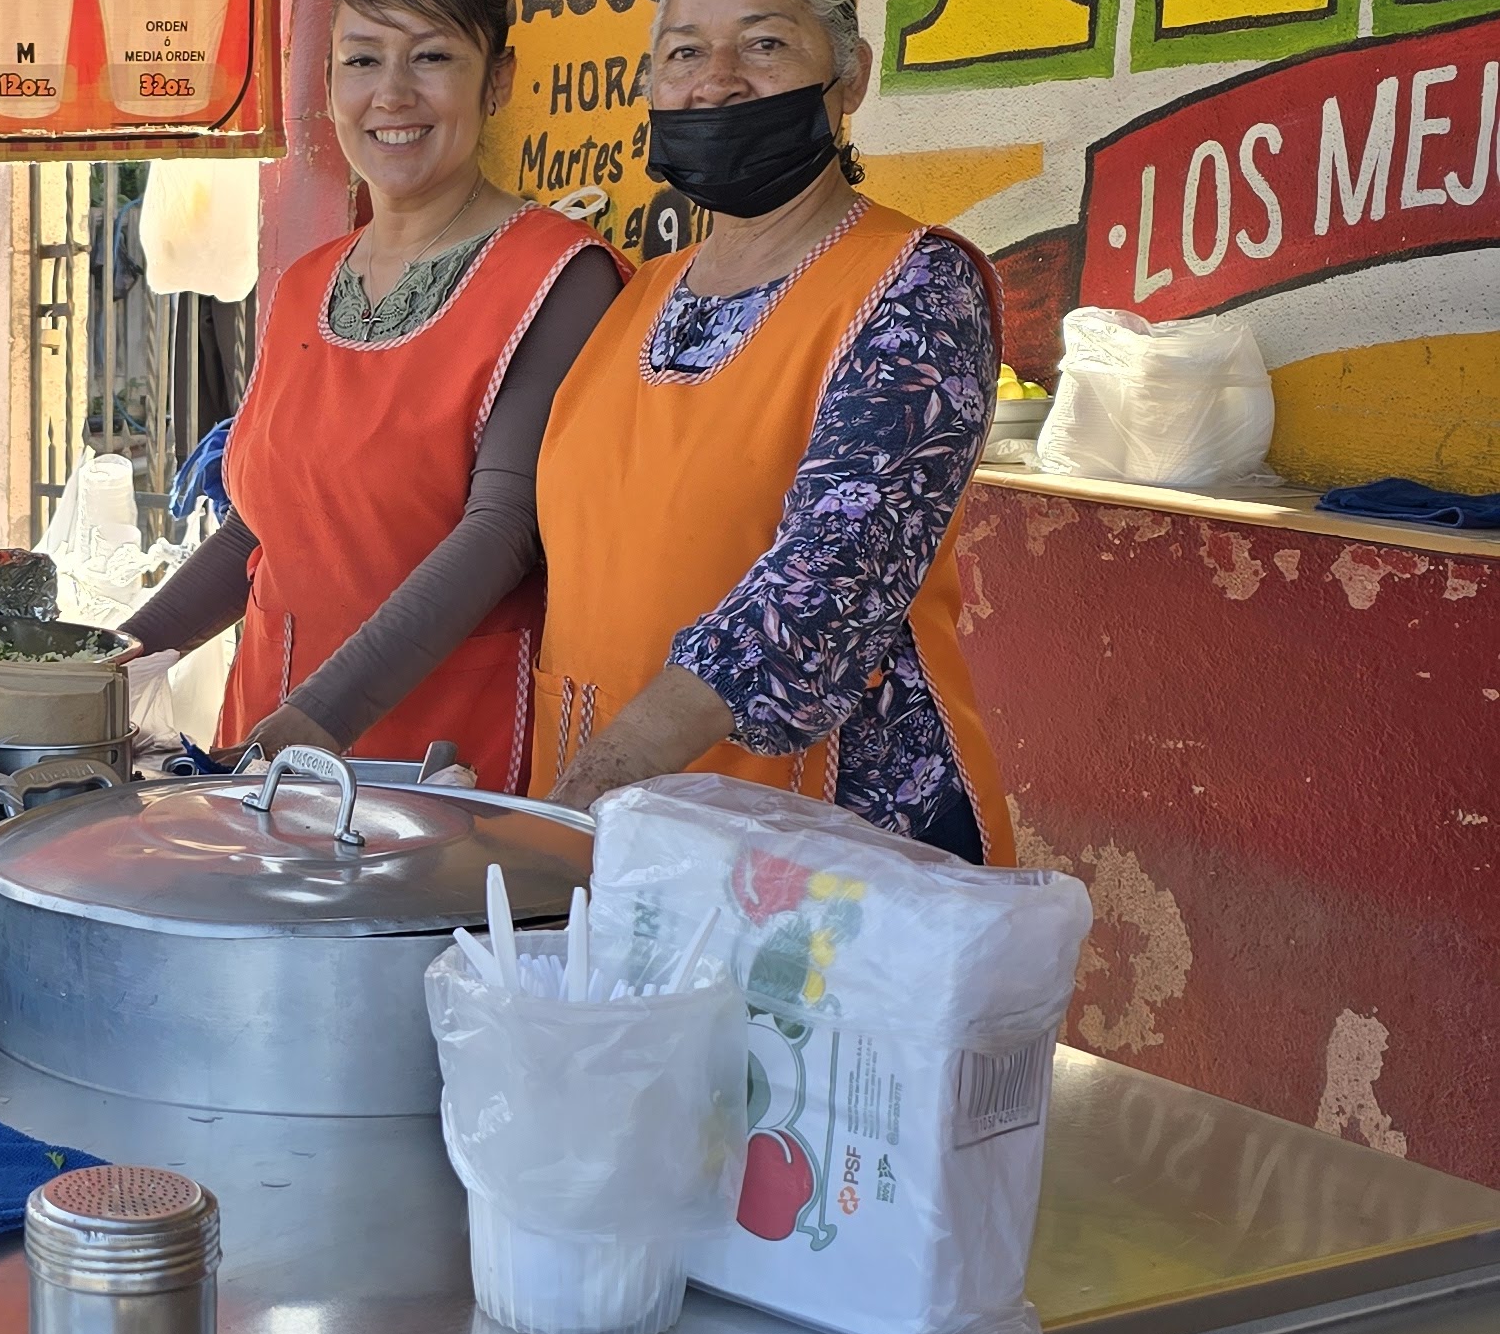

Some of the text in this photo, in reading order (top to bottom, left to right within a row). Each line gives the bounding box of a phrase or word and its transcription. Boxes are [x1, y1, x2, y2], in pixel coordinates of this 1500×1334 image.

[145, 20, 189, 33] ORDEN
[16, 41, 36, 64] M
[164, 36, 171, 48] ó
[124, 49, 206, 63] MEDIA ORDEN
[139, 72, 195, 98] 32oz.
[550, 51, 652, 115] HORA
[518, 131, 624, 192] Martes
[1134, 61, 1500, 303] LOS MEJ
[844, 1144, 862, 1185] PSF
